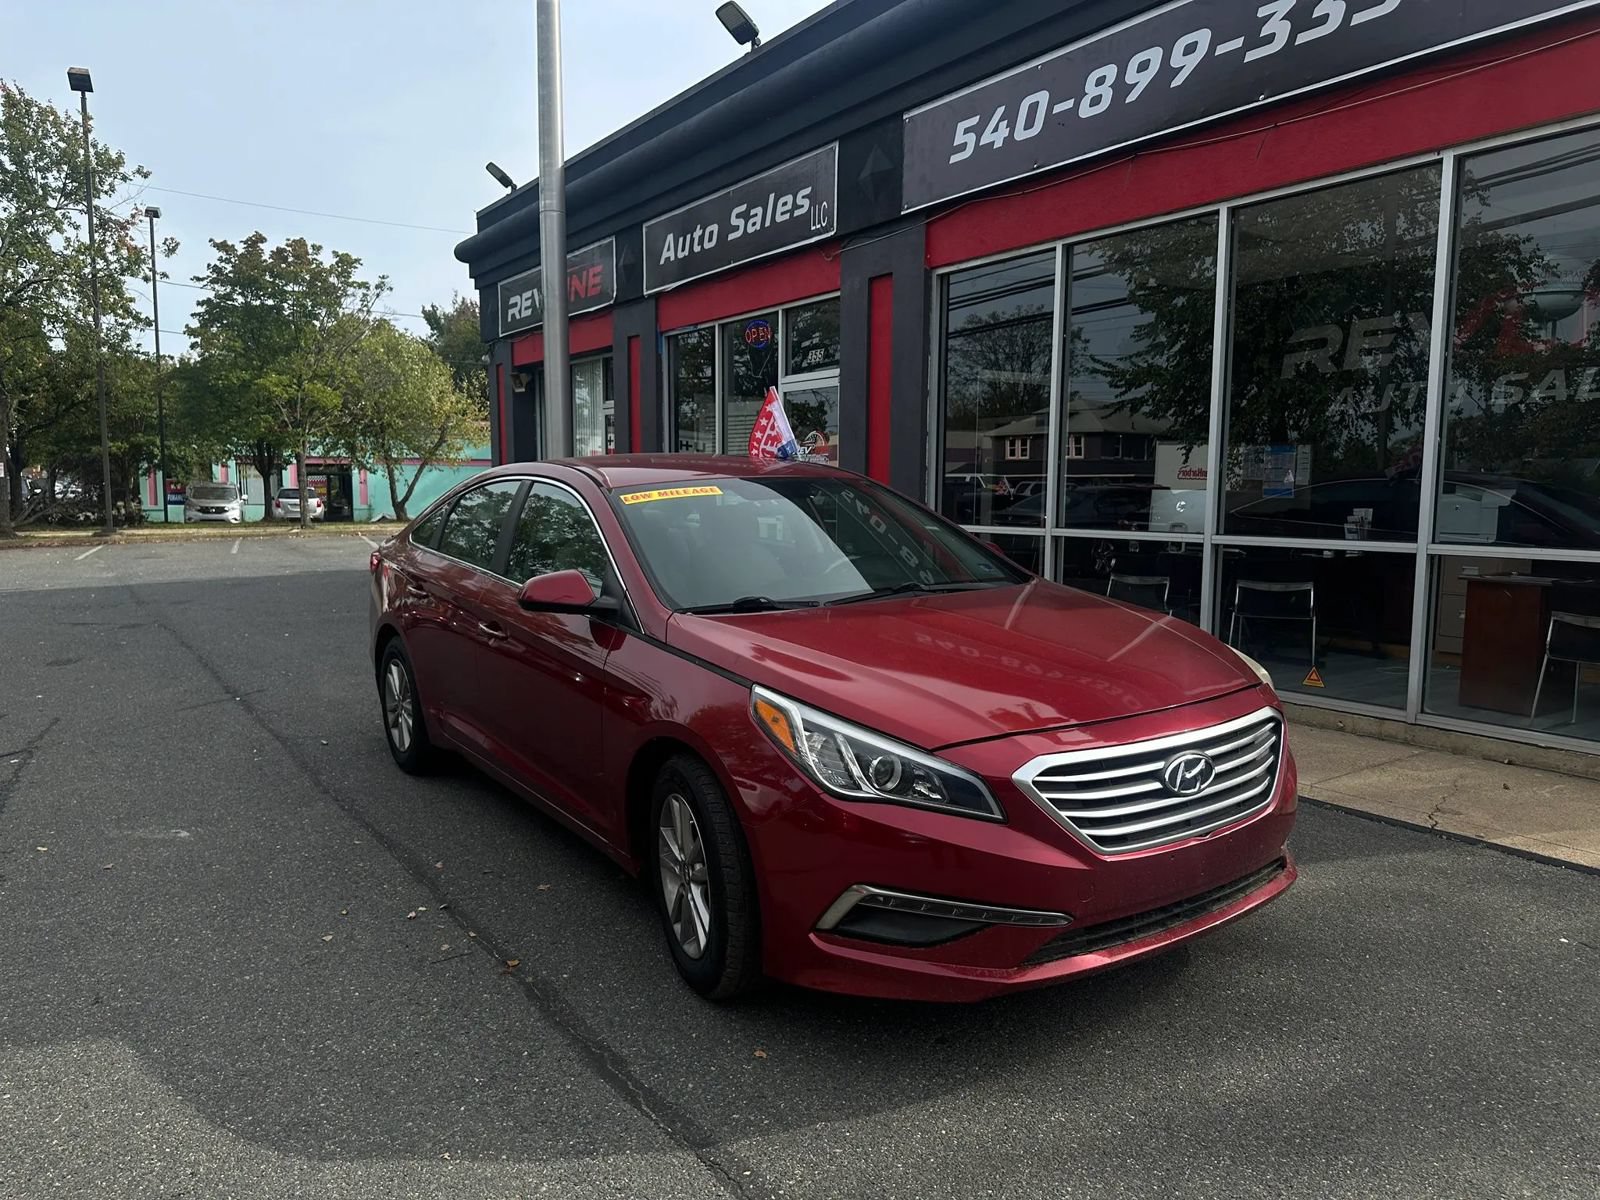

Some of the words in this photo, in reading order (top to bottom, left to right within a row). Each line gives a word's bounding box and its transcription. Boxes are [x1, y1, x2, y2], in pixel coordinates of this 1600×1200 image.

[810, 201, 828, 231] LLC
[659, 223, 719, 265] Auto
[727, 186, 812, 241] Sales
[745, 327, 771, 343] OPEN
[808, 349, 824, 362] 355
[623, 492, 651, 502] LOW
[657, 487, 718, 497] MILEAGE
